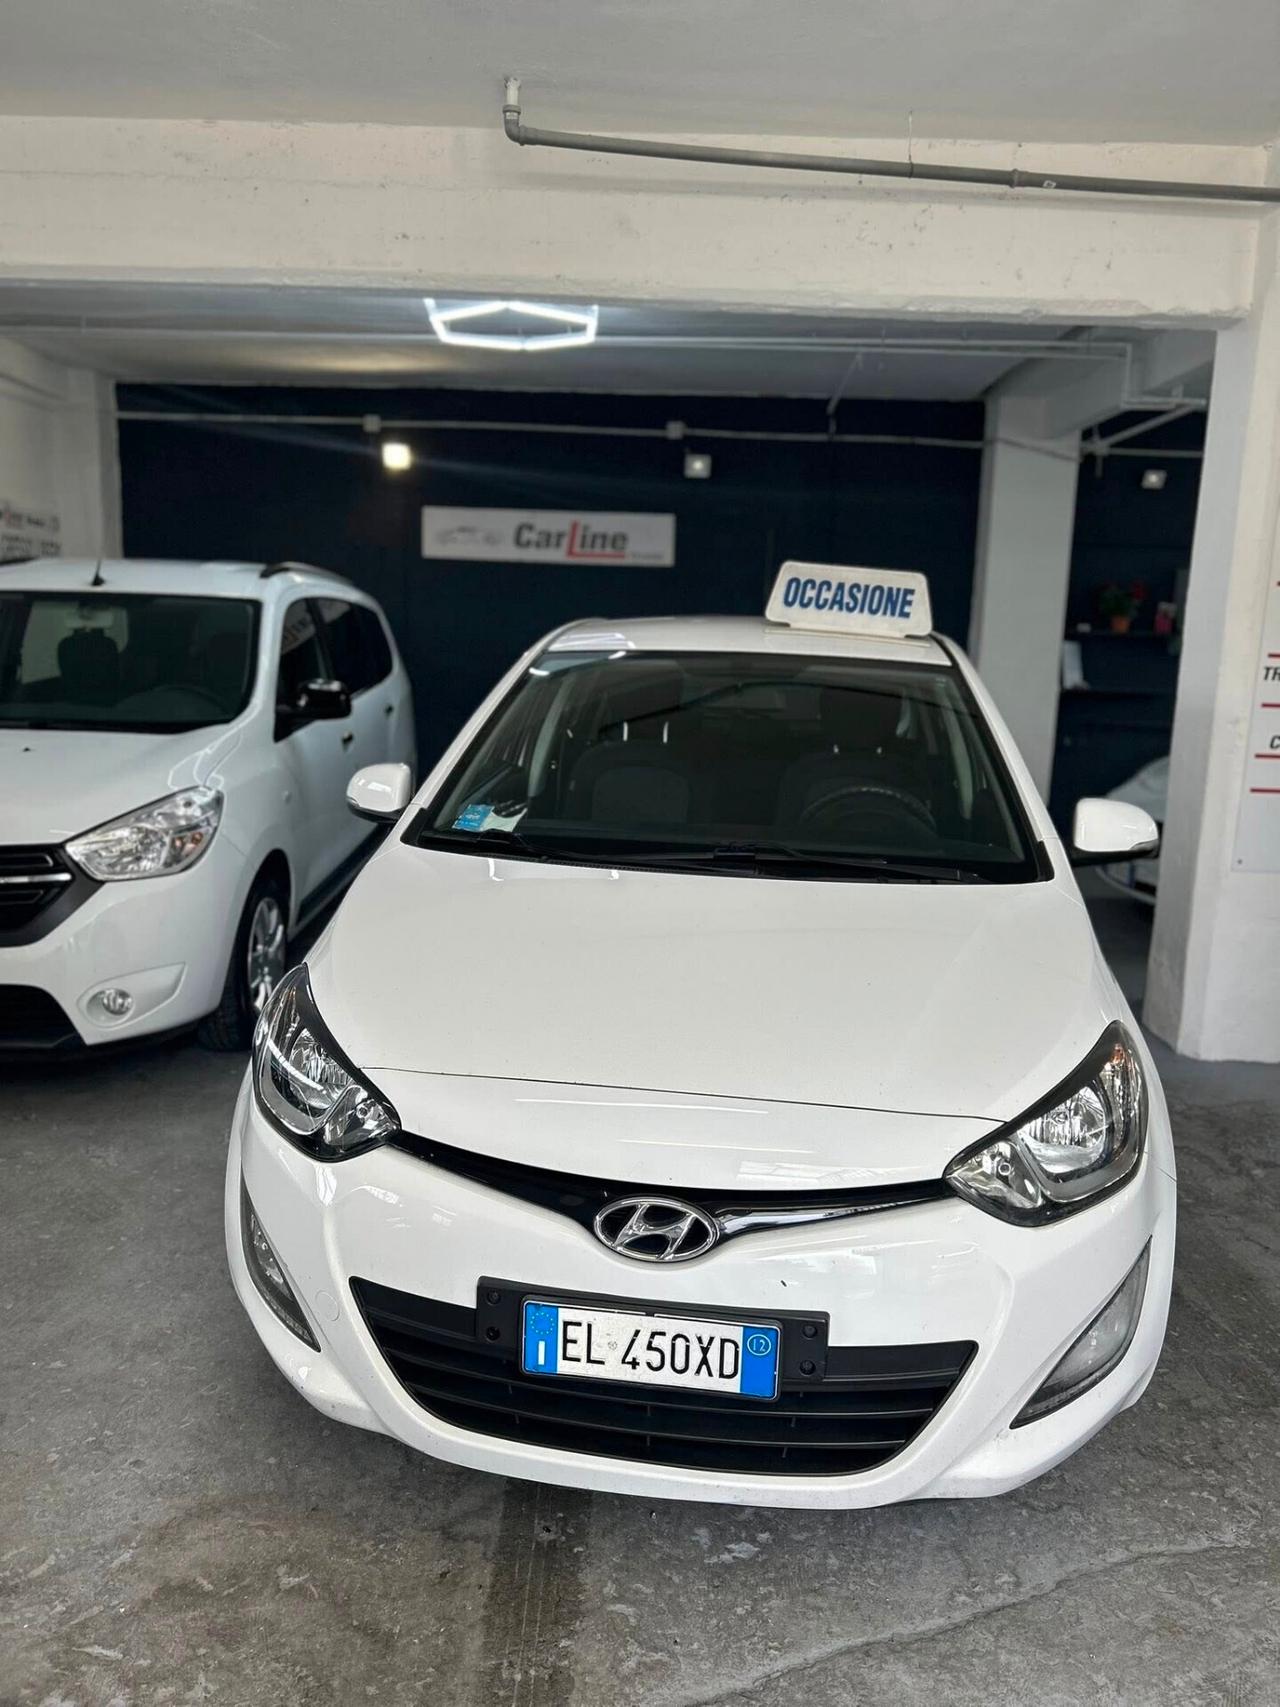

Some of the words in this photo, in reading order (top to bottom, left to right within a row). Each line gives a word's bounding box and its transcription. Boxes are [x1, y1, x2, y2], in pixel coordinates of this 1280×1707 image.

[513, 520, 629, 559] CarLine
[783, 577, 916, 619] OCCASIONE
[562, 1320, 606, 1366] EL
[621, 1328, 740, 1380] 450XD
[751, 1337, 768, 1353] 12
